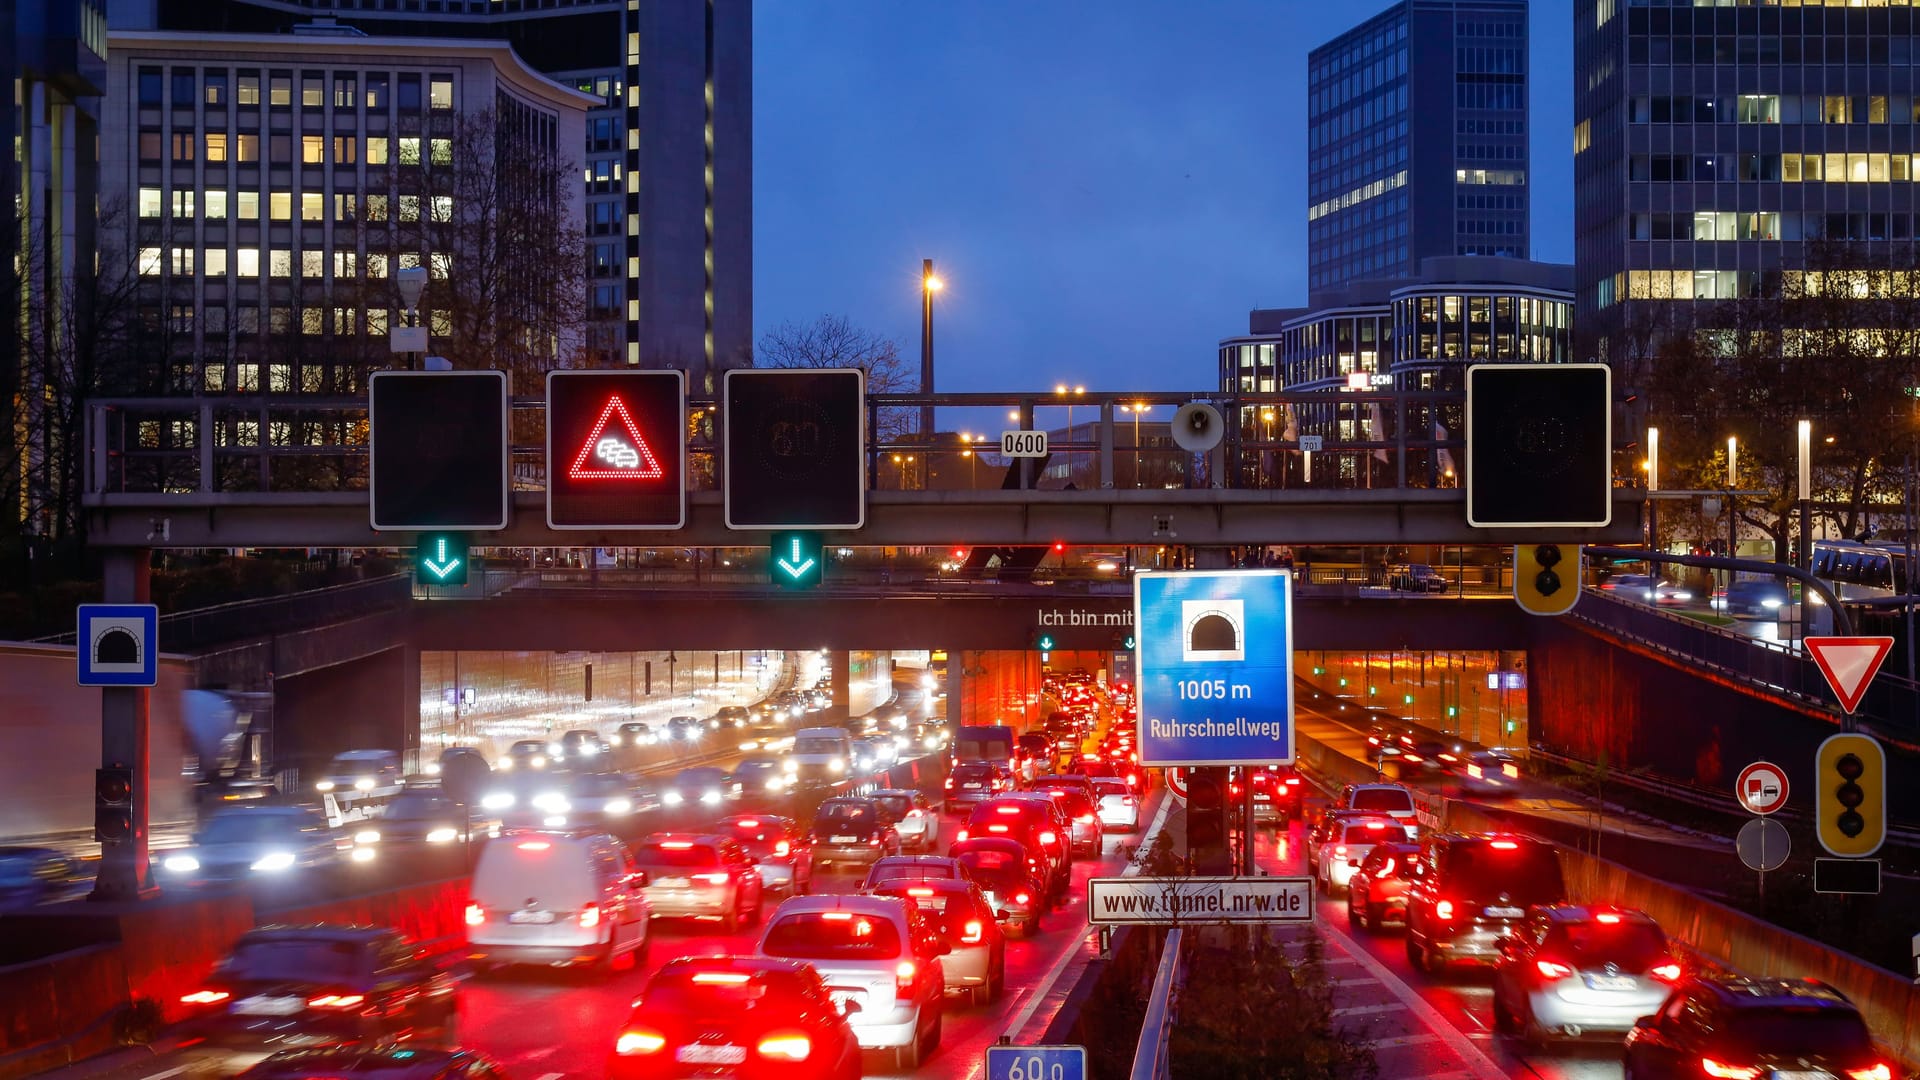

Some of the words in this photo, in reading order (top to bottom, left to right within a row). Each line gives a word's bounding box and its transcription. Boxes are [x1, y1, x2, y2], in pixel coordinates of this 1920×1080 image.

[1371, 375, 1393, 385] SCH
[1005, 434, 1044, 453] 0600
[1304, 442, 1318, 450] 701
[1038, 609, 1064, 626] Ich
[1070, 609, 1097, 626] bin
[1103, 609, 1133, 626] mit
[1178, 680, 1226, 700] 1005
[1231, 684, 1252, 699] m
[1150, 717, 1280, 741] Ruhrschnellweg
[1103, 888, 1301, 913] www.tunnel.nrw.de
